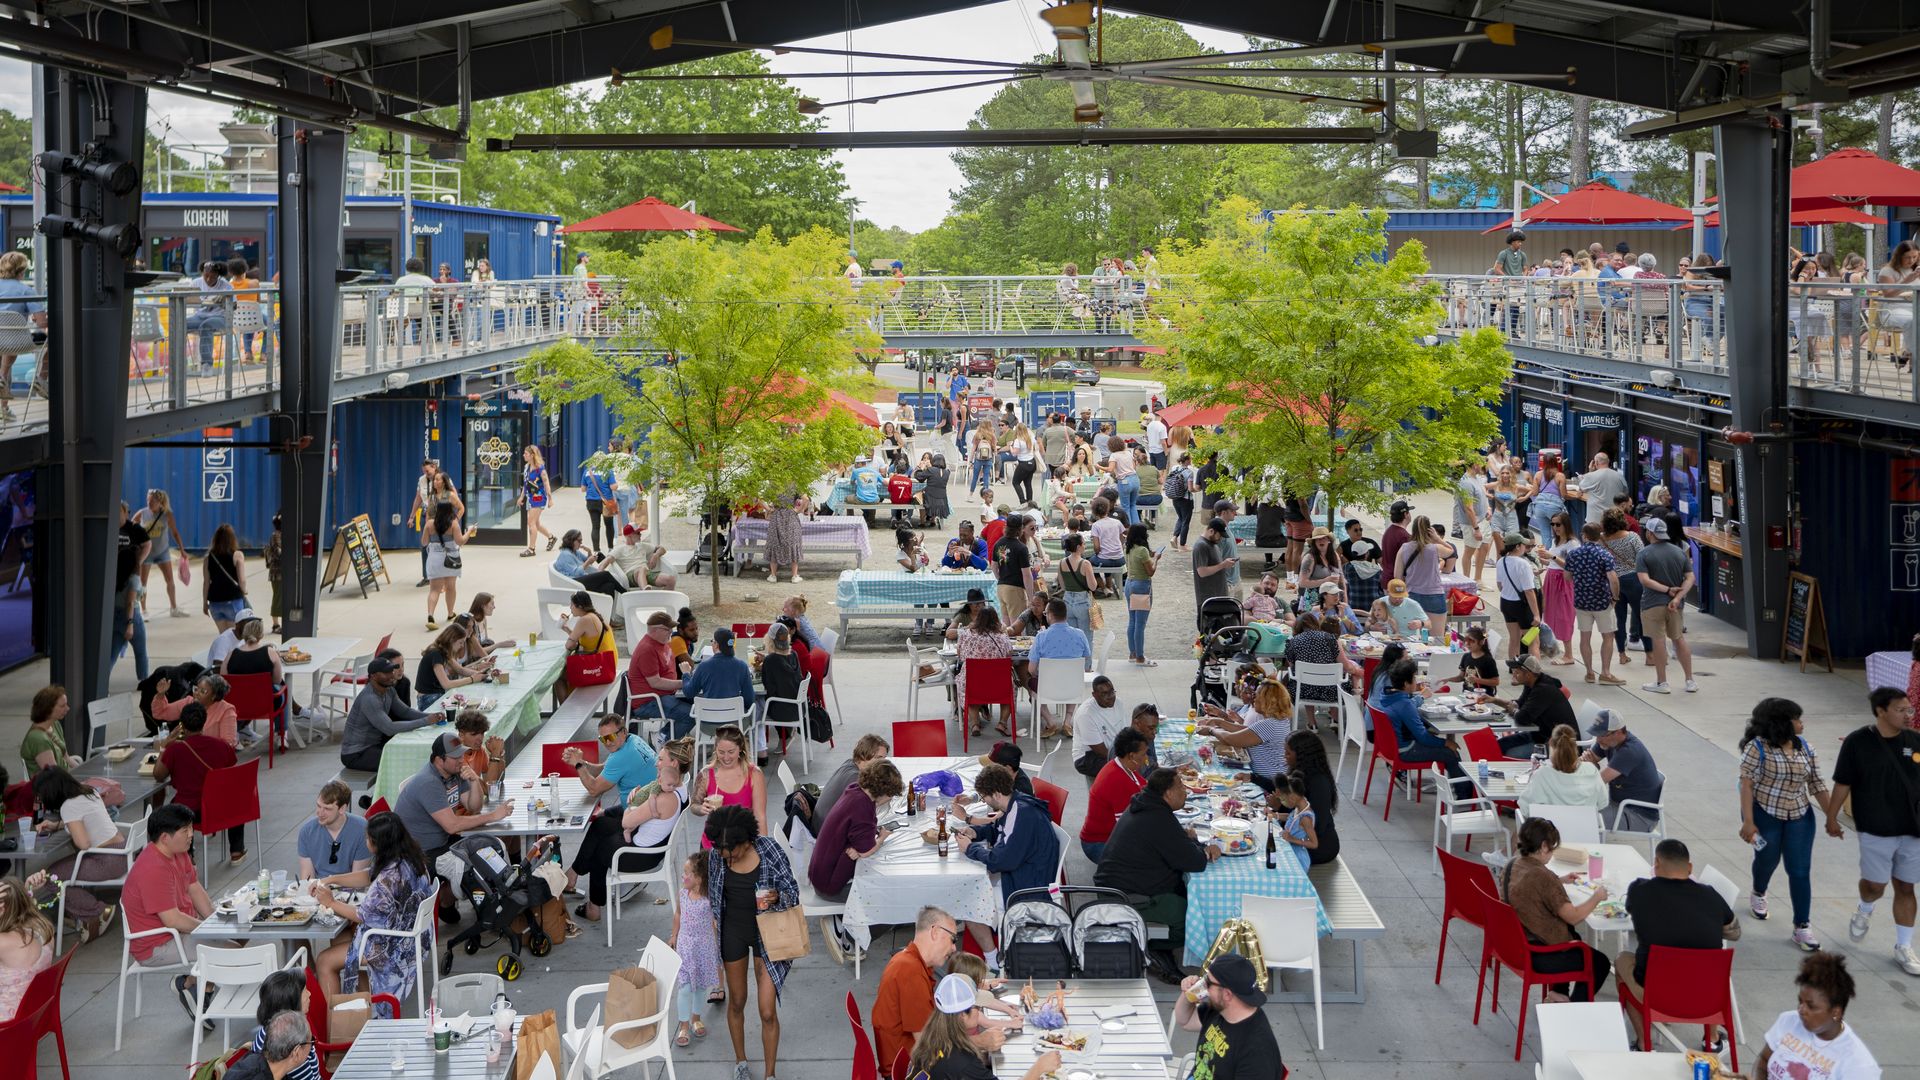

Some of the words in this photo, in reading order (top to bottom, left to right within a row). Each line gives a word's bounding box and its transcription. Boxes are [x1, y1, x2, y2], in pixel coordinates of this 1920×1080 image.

[184, 209, 229, 227] KOREAN
[468, 420, 490, 432] 160
[1580, 415, 1621, 428] LAWRENCE
[1637, 437, 1649, 452] 120
[898, 486, 906, 499] 7
